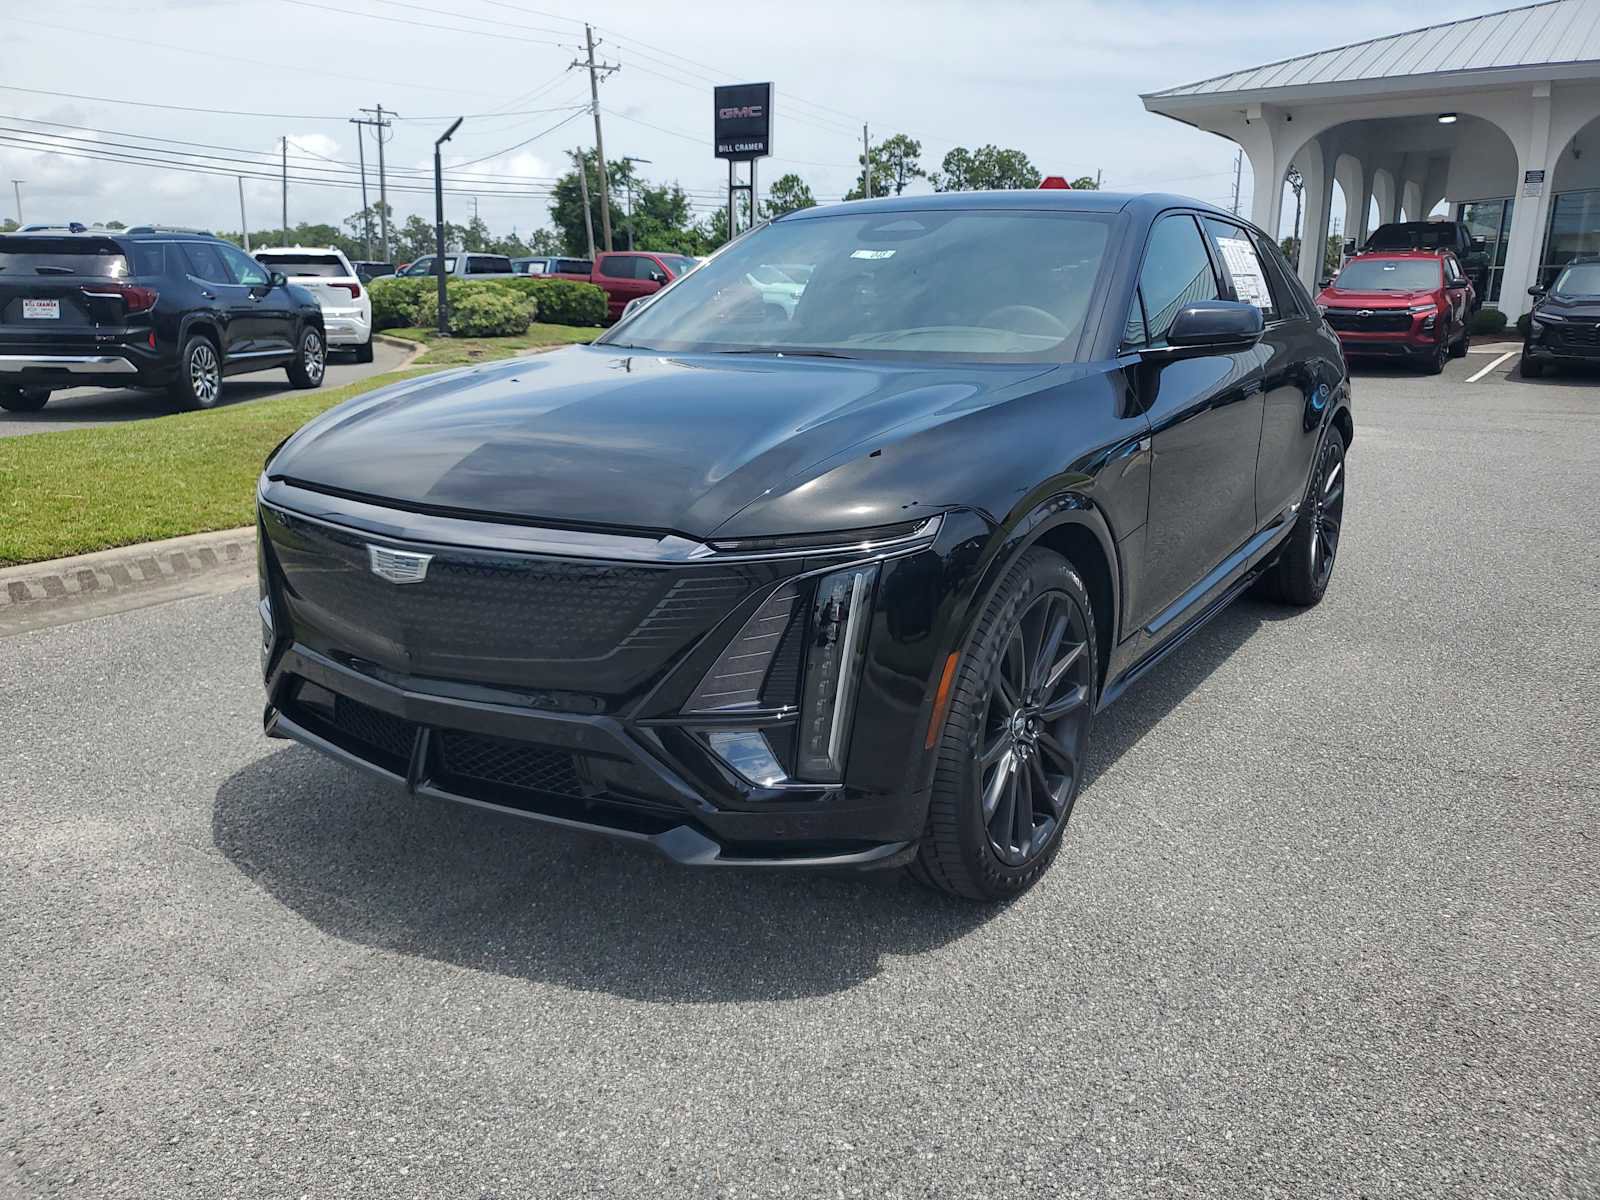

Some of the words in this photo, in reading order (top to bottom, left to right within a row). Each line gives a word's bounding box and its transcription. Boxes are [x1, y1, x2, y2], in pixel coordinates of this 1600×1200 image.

[719, 105, 762, 119] GMC
[718, 144, 733, 153] BILL
[735, 142, 764, 152] CRAMER
